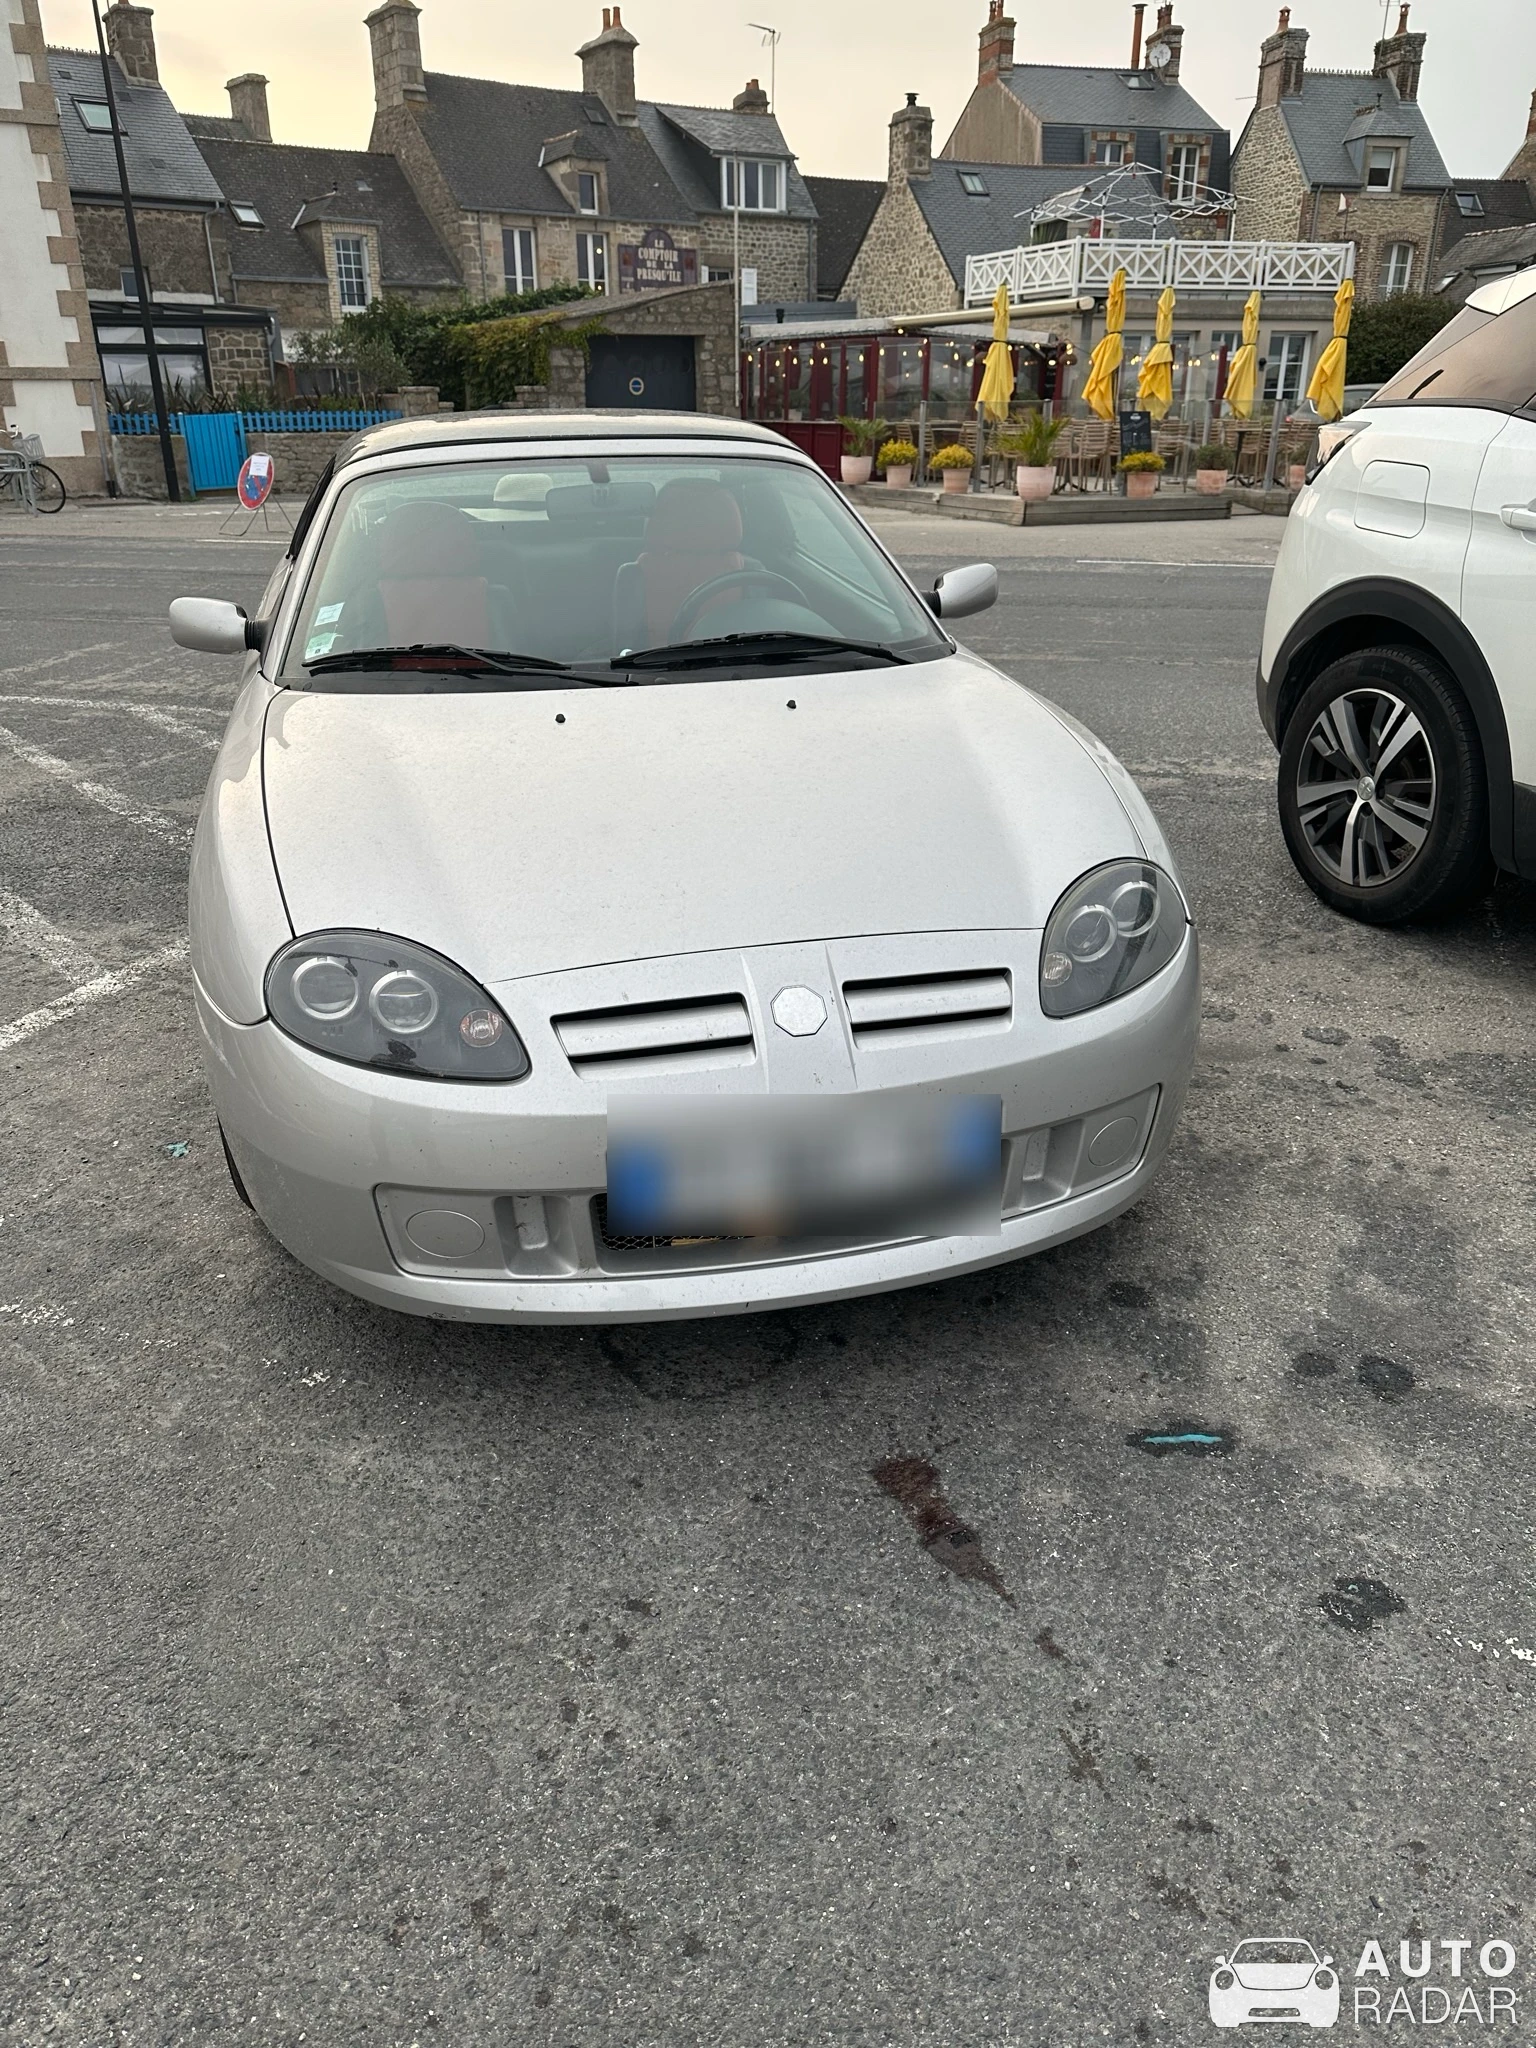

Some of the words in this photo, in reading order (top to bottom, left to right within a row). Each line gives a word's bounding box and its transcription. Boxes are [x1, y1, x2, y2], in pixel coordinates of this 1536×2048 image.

[654, 239, 665, 248] LE
[638, 247, 679, 262] COMPTOIR
[646, 260, 657, 268] DE
[664, 261, 674, 270] LA
